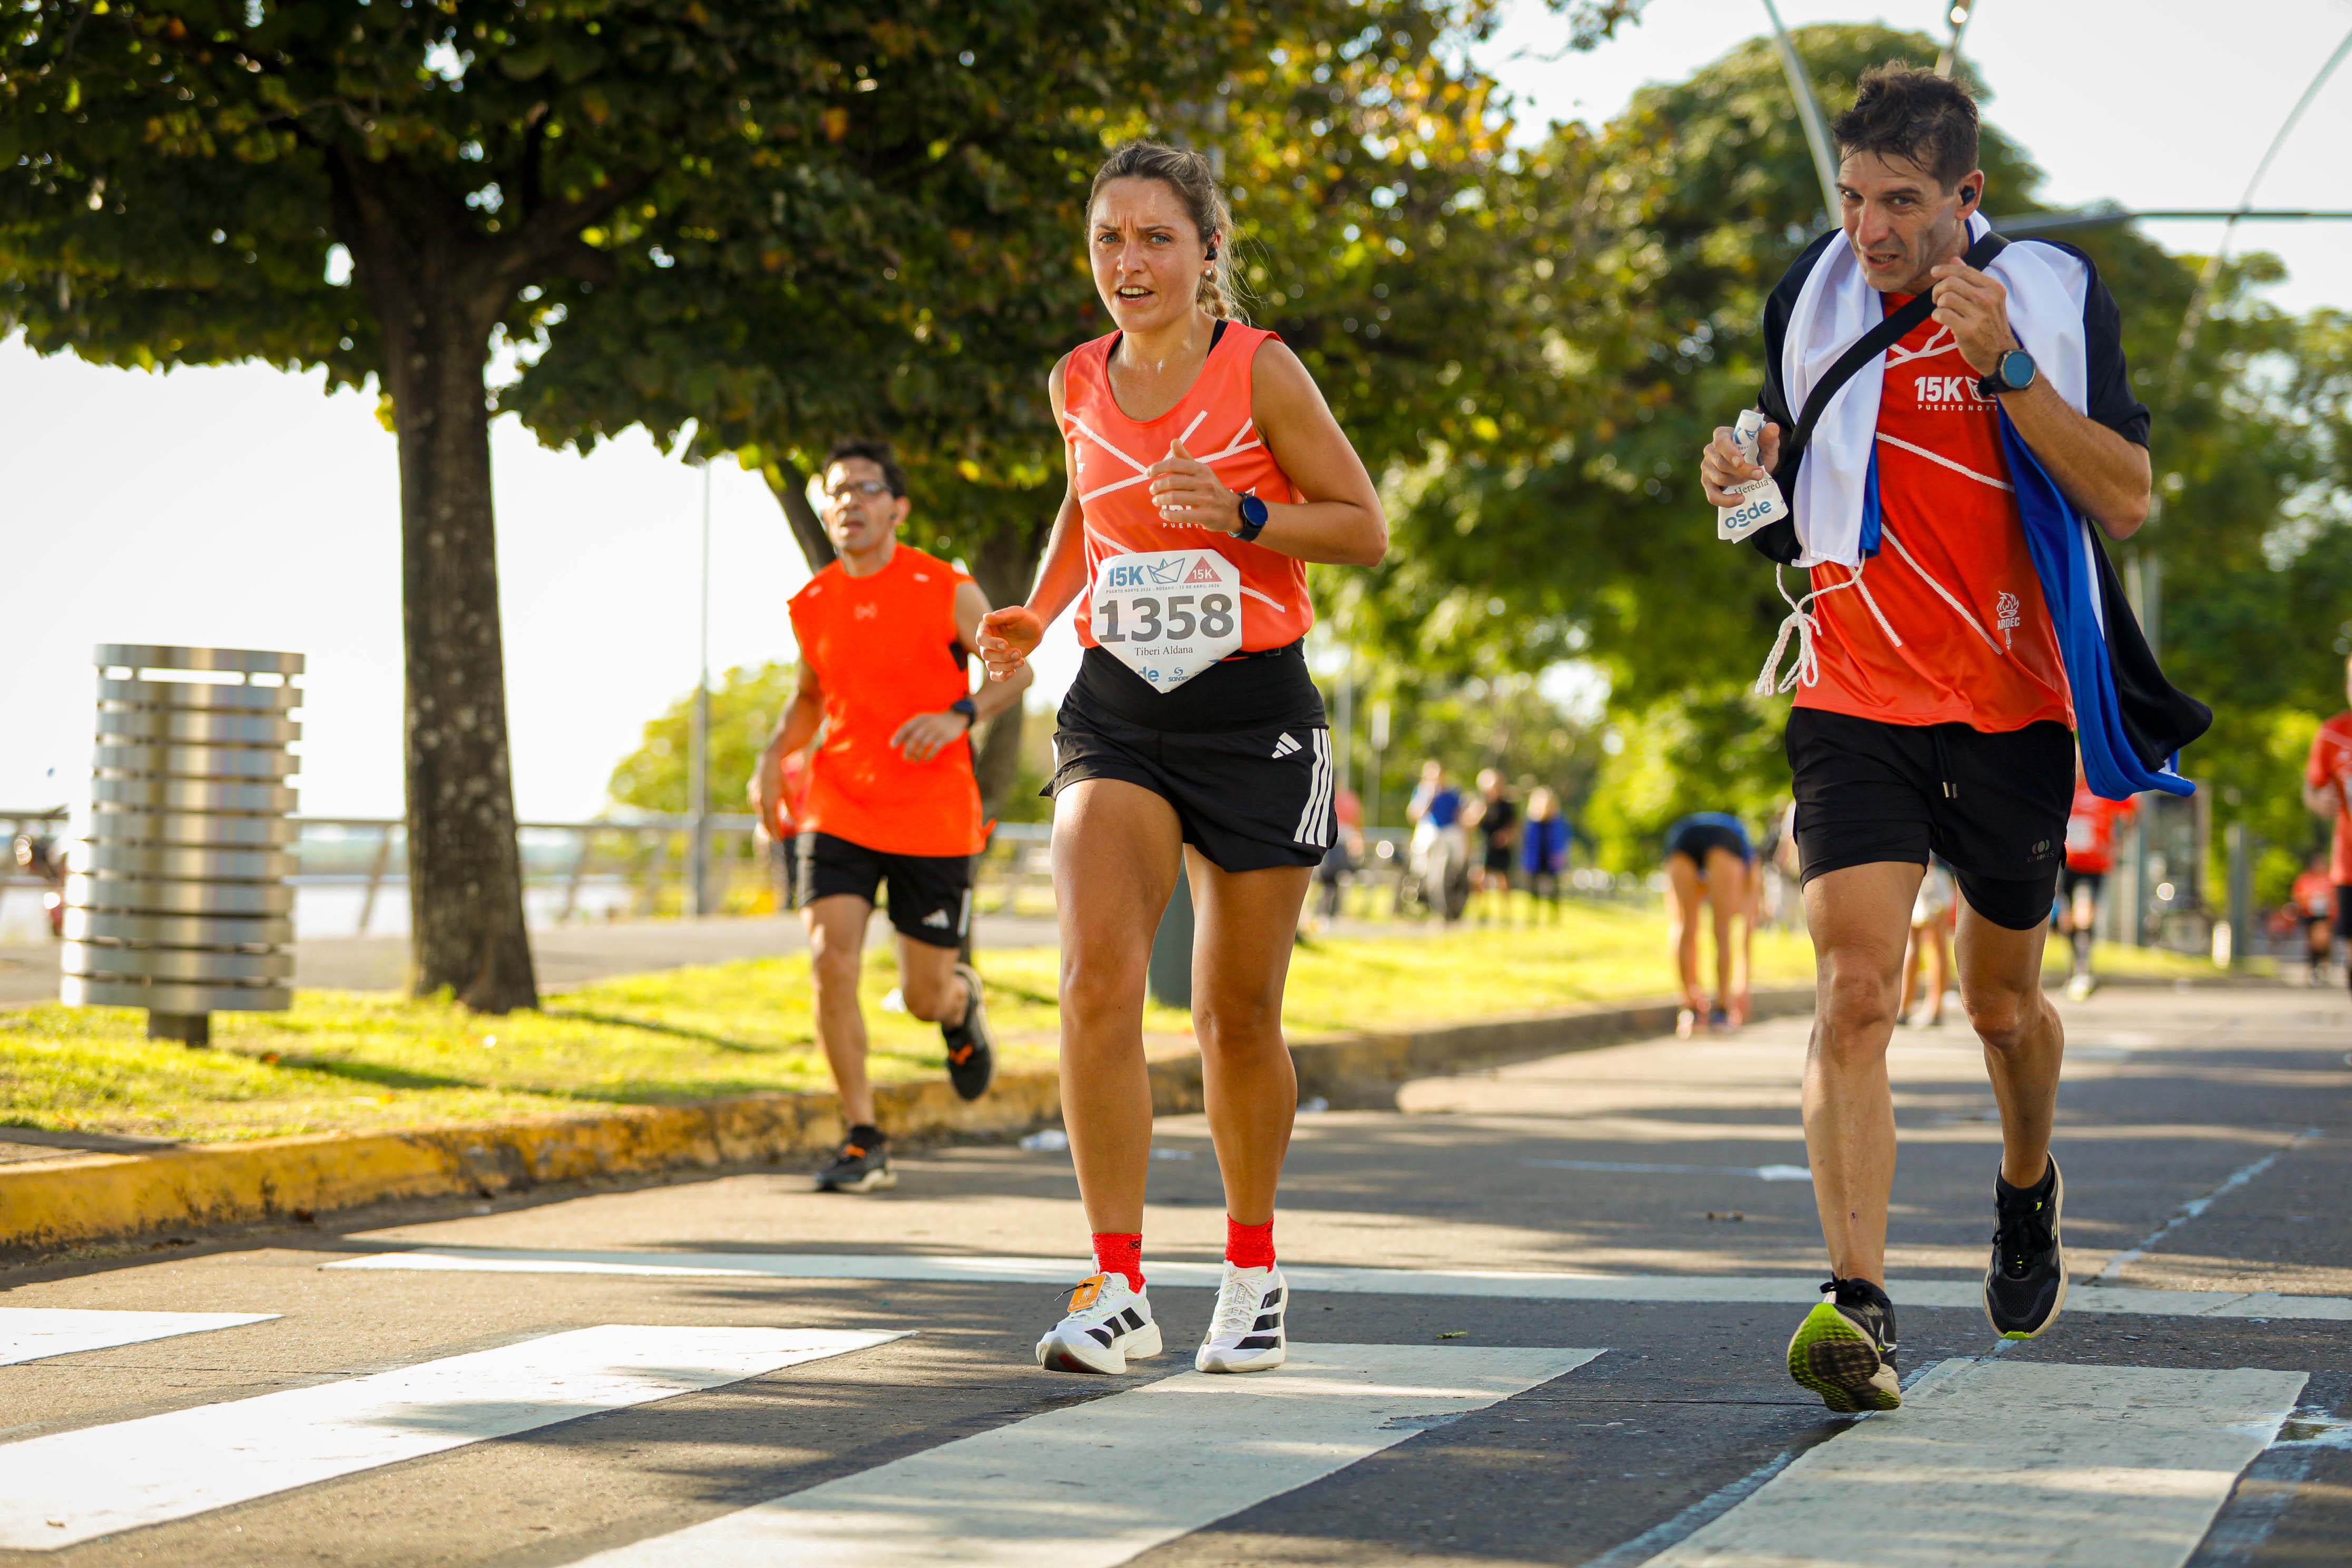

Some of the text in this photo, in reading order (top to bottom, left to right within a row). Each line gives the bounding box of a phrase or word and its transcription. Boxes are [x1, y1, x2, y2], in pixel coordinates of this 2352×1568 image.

[1915, 376, 1964, 401] 15K
[1734, 479, 1769, 494] Heredia
[1725, 501, 1772, 529] osde
[1108, 565, 1144, 586] 15K
[1192, 569, 1213, 580] 15K
[1099, 593, 1234, 643] 1358
[1997, 616, 2020, 631] ARDEC
[1134, 645, 1193, 656] Tiberi Aldana
